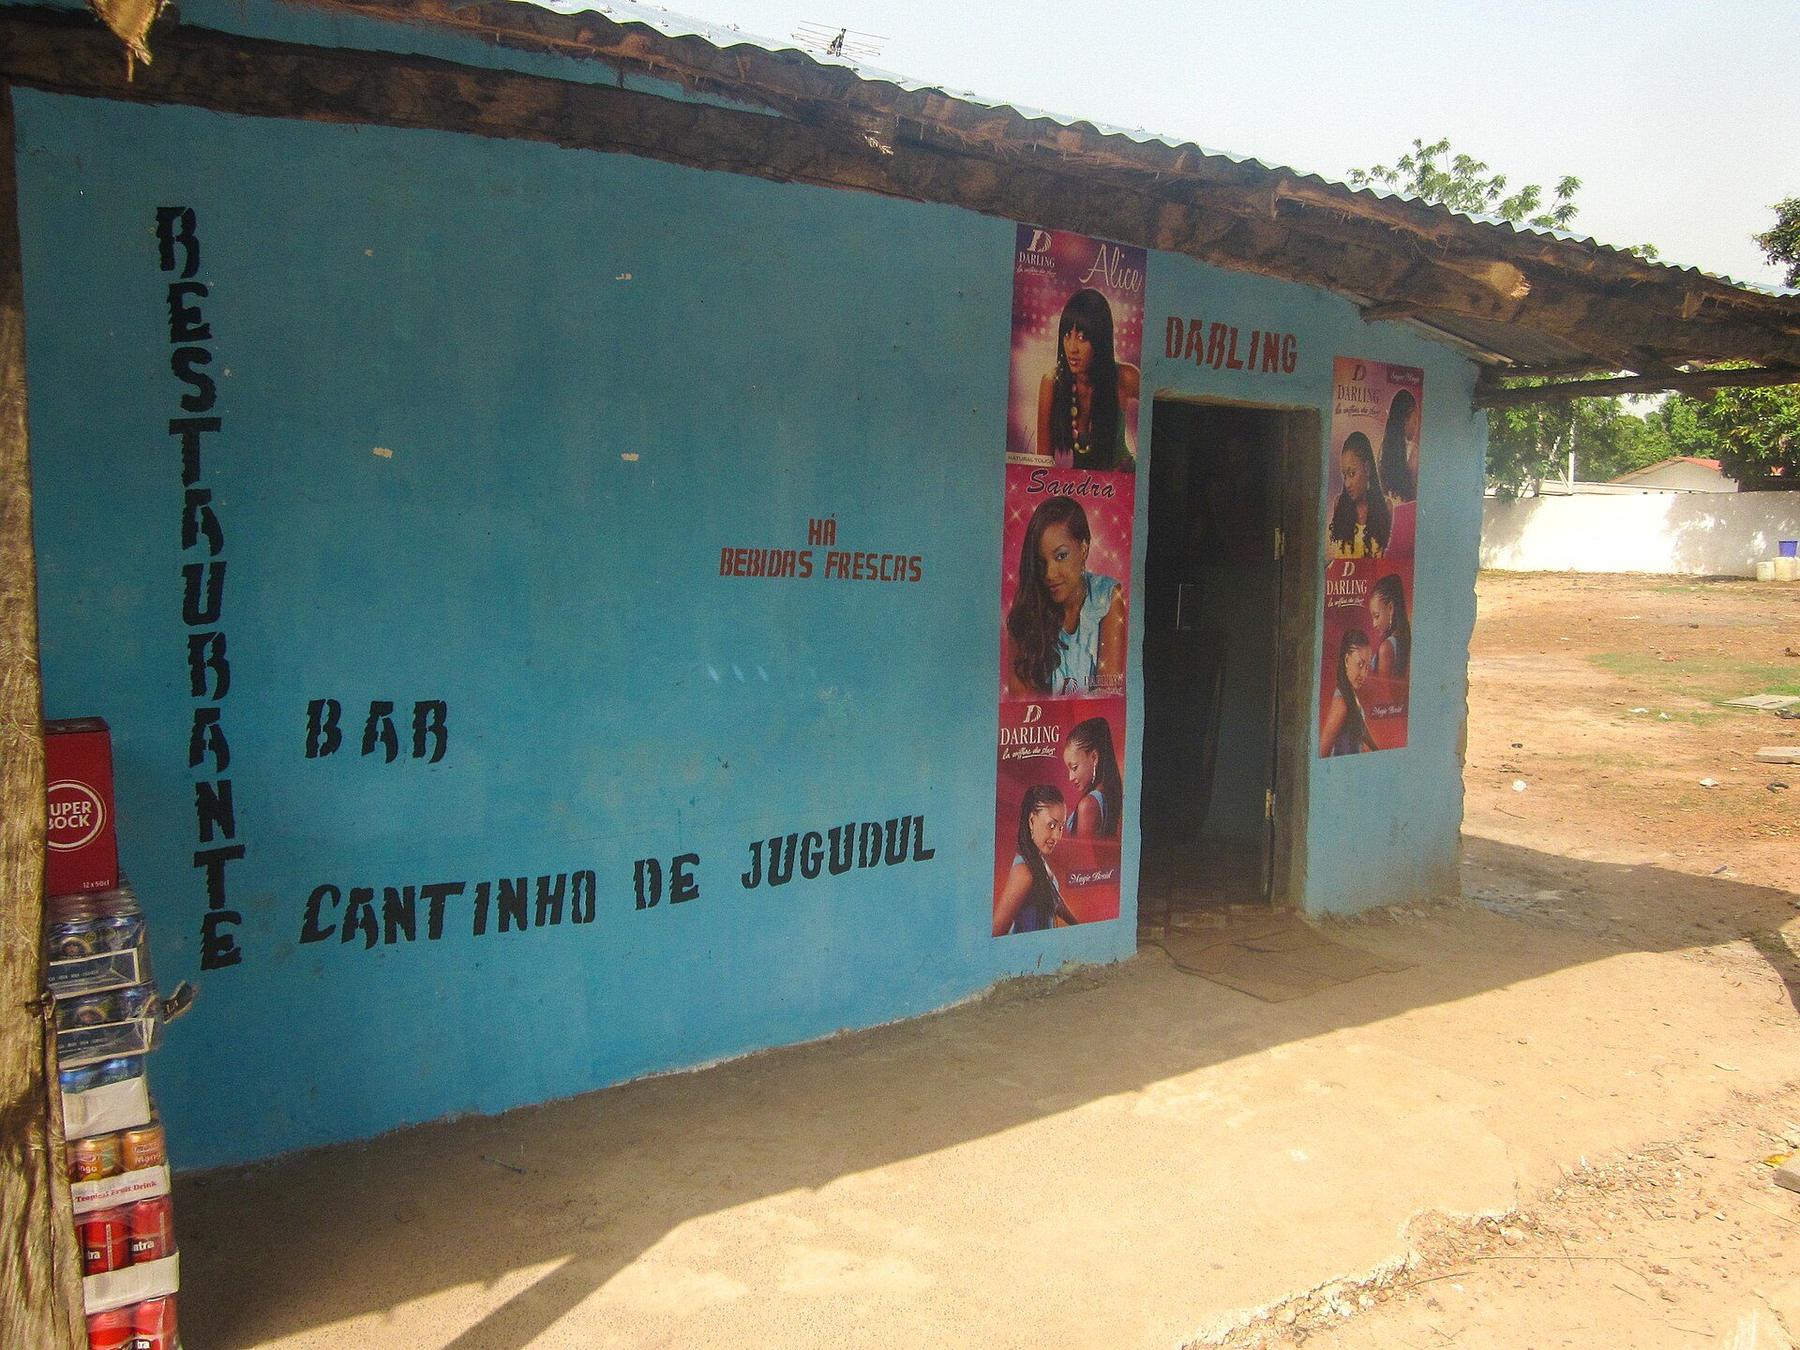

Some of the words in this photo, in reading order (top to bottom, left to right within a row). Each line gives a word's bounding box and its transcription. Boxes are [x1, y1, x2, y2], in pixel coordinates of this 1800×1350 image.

[1019, 251, 1055, 268] DARLING
[1079, 243, 1142, 293] Alice
[1165, 316, 1298, 374] DARLING
[1337, 384, 1379, 404] DARLING
[1027, 468, 1116, 498] Sandra
[807, 512, 836, 546] HÁ
[719, 547, 813, 578] BEBIDAS
[824, 551, 922, 582] FRESCAS
[156, 206, 245, 971] RESTAURANTE
[1327, 579, 1367, 595] DARLING
[304, 698, 448, 764] BAR
[1000, 724, 1060, 746] DARLING
[50, 801, 92, 817] UPER
[299, 870, 597, 949] CANTINHO
[633, 853, 700, 911] DE
[741, 815, 936, 889] JUGUDUL
[75, 1189, 110, 1202] Tropical
[110, 1185, 133, 1197] Fruit
[133, 1179, 157, 1192] Drink
[133, 1240, 155, 1252] atra
